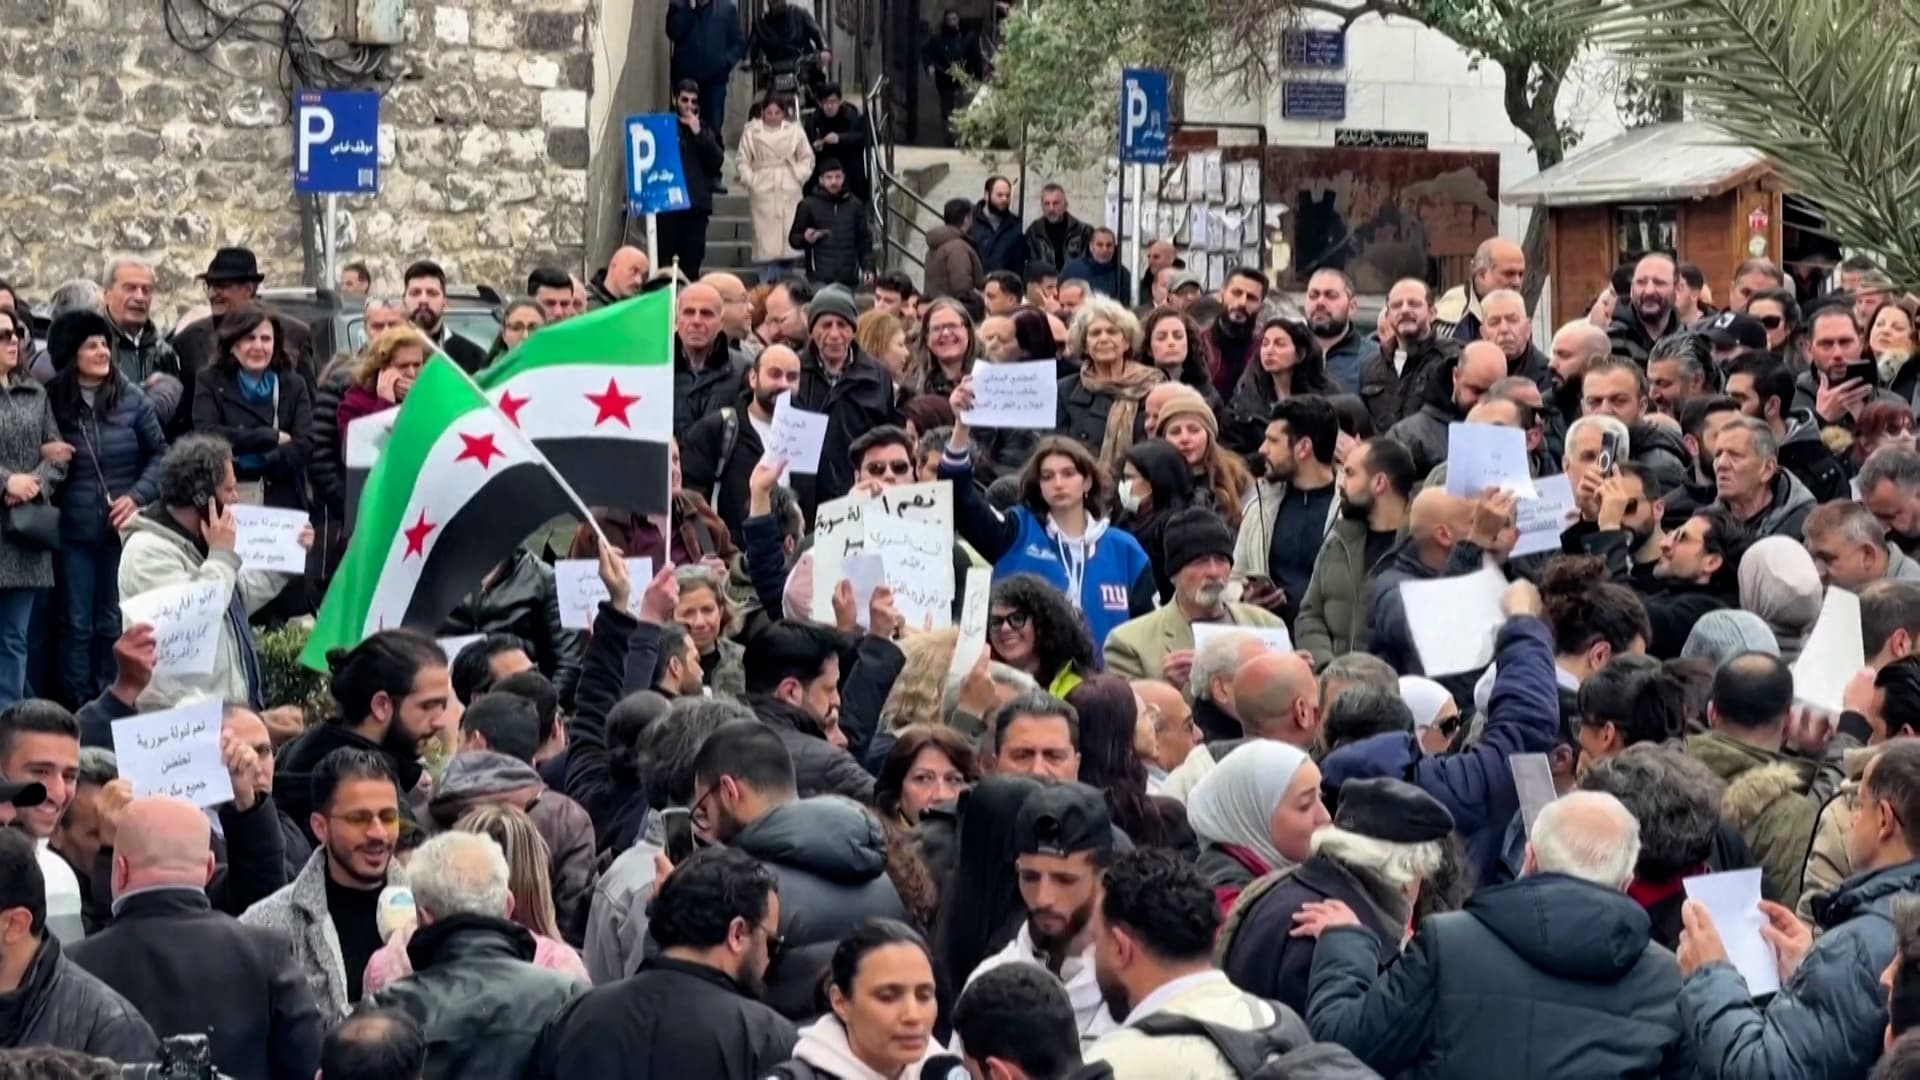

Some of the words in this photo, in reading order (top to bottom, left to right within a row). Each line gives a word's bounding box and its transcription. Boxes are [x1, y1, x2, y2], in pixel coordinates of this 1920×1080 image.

[1127, 86, 1148, 146] P
[299, 106, 334, 173] P
[350, 139, 373, 155] موقف
[631, 127, 656, 194] P
[897, 488, 936, 518] نعم
[136, 732, 169, 750] سورية
[186, 780, 206, 799] جميع
